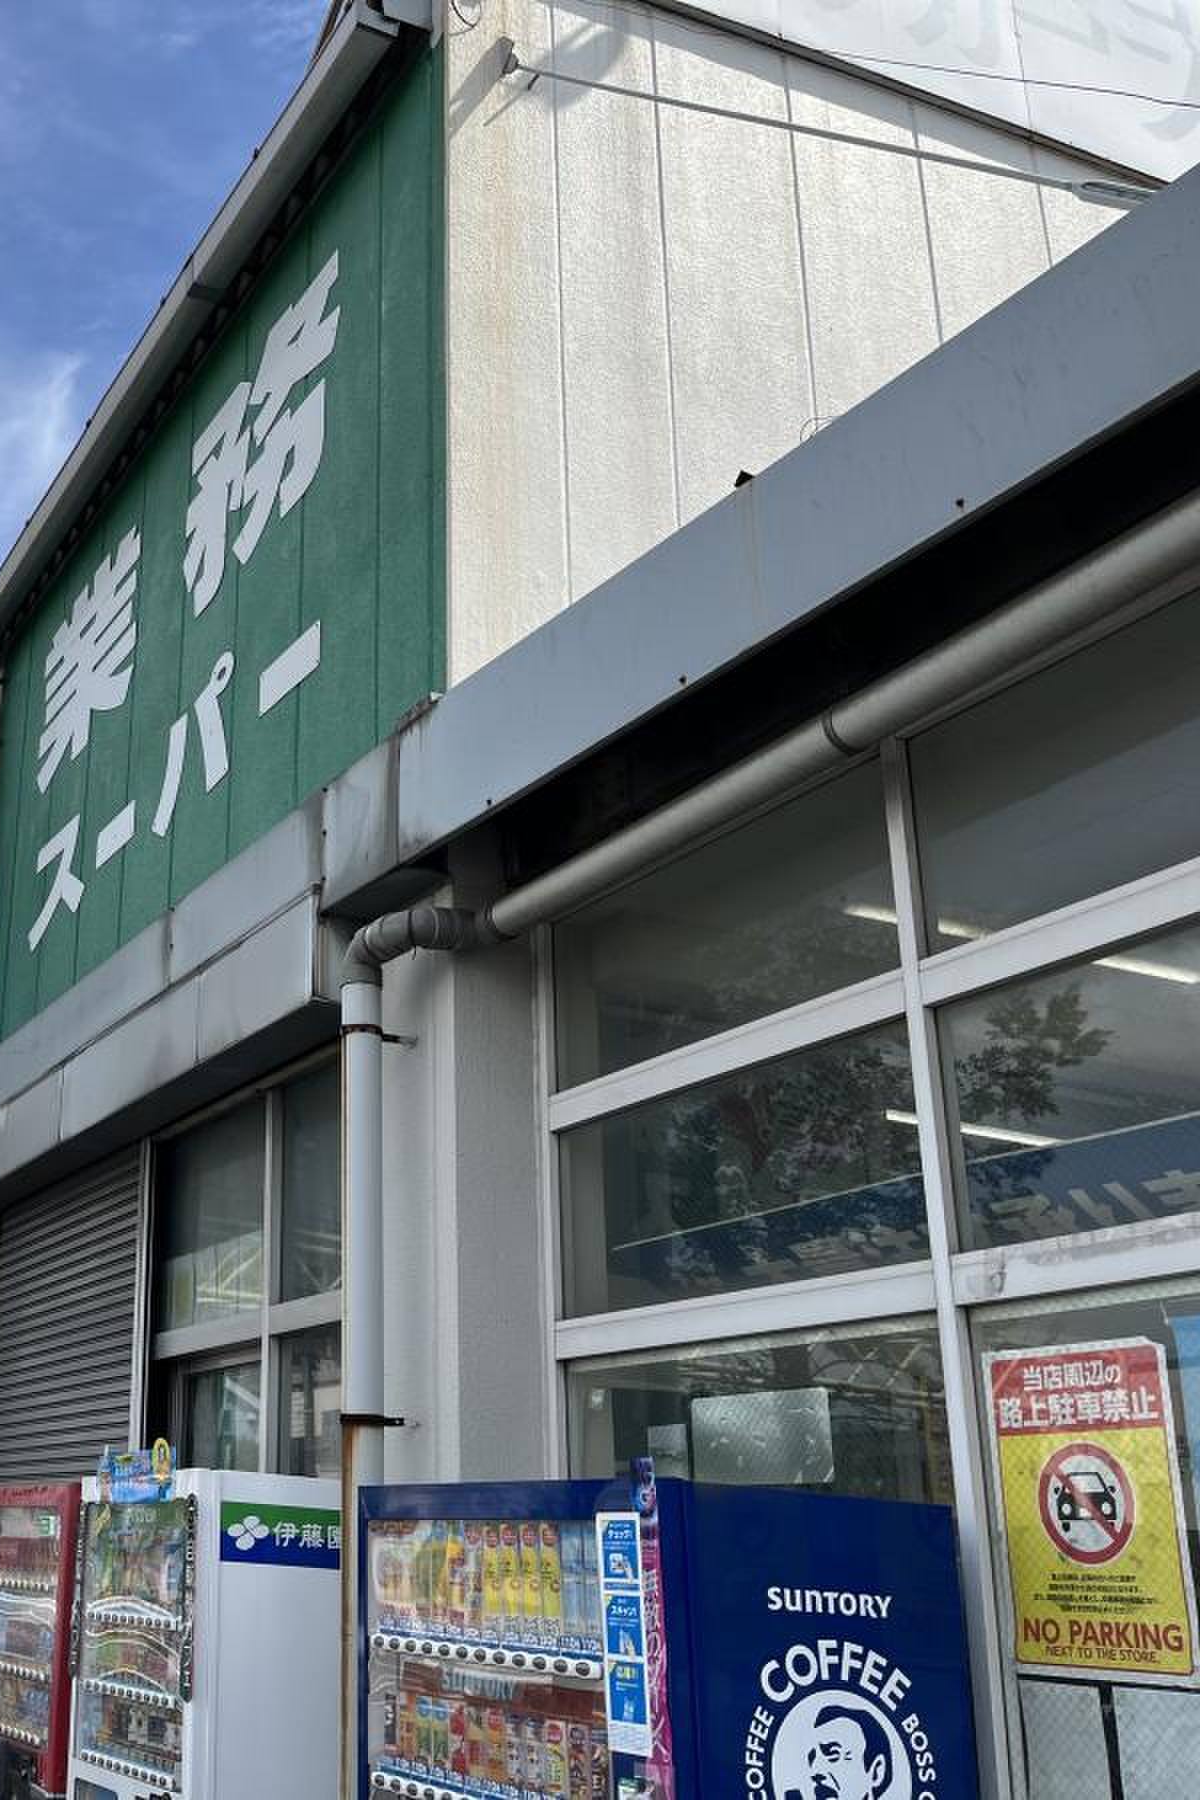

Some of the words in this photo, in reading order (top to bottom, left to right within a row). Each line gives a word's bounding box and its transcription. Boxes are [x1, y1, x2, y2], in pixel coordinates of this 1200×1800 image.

[36, 249, 340, 794] 業務
[29, 620, 321, 952] スーパー
[1023, 1360, 1121, 1392] 当店周辺の
[999, 1386, 1159, 1429] 路上駐車禁止
[767, 1586, 892, 1618] SUNTORY
[1023, 1618, 1060, 1644] NO
[1070, 1620, 1184, 1652] PARKING
[1045, 1645, 1073, 1657] NEXT
[1078, 1647, 1092, 1659] TO
[1096, 1648, 1117, 1661] THE
[760, 1639, 912, 1711] COFFEE
[901, 1713, 937, 1783] BOSS
